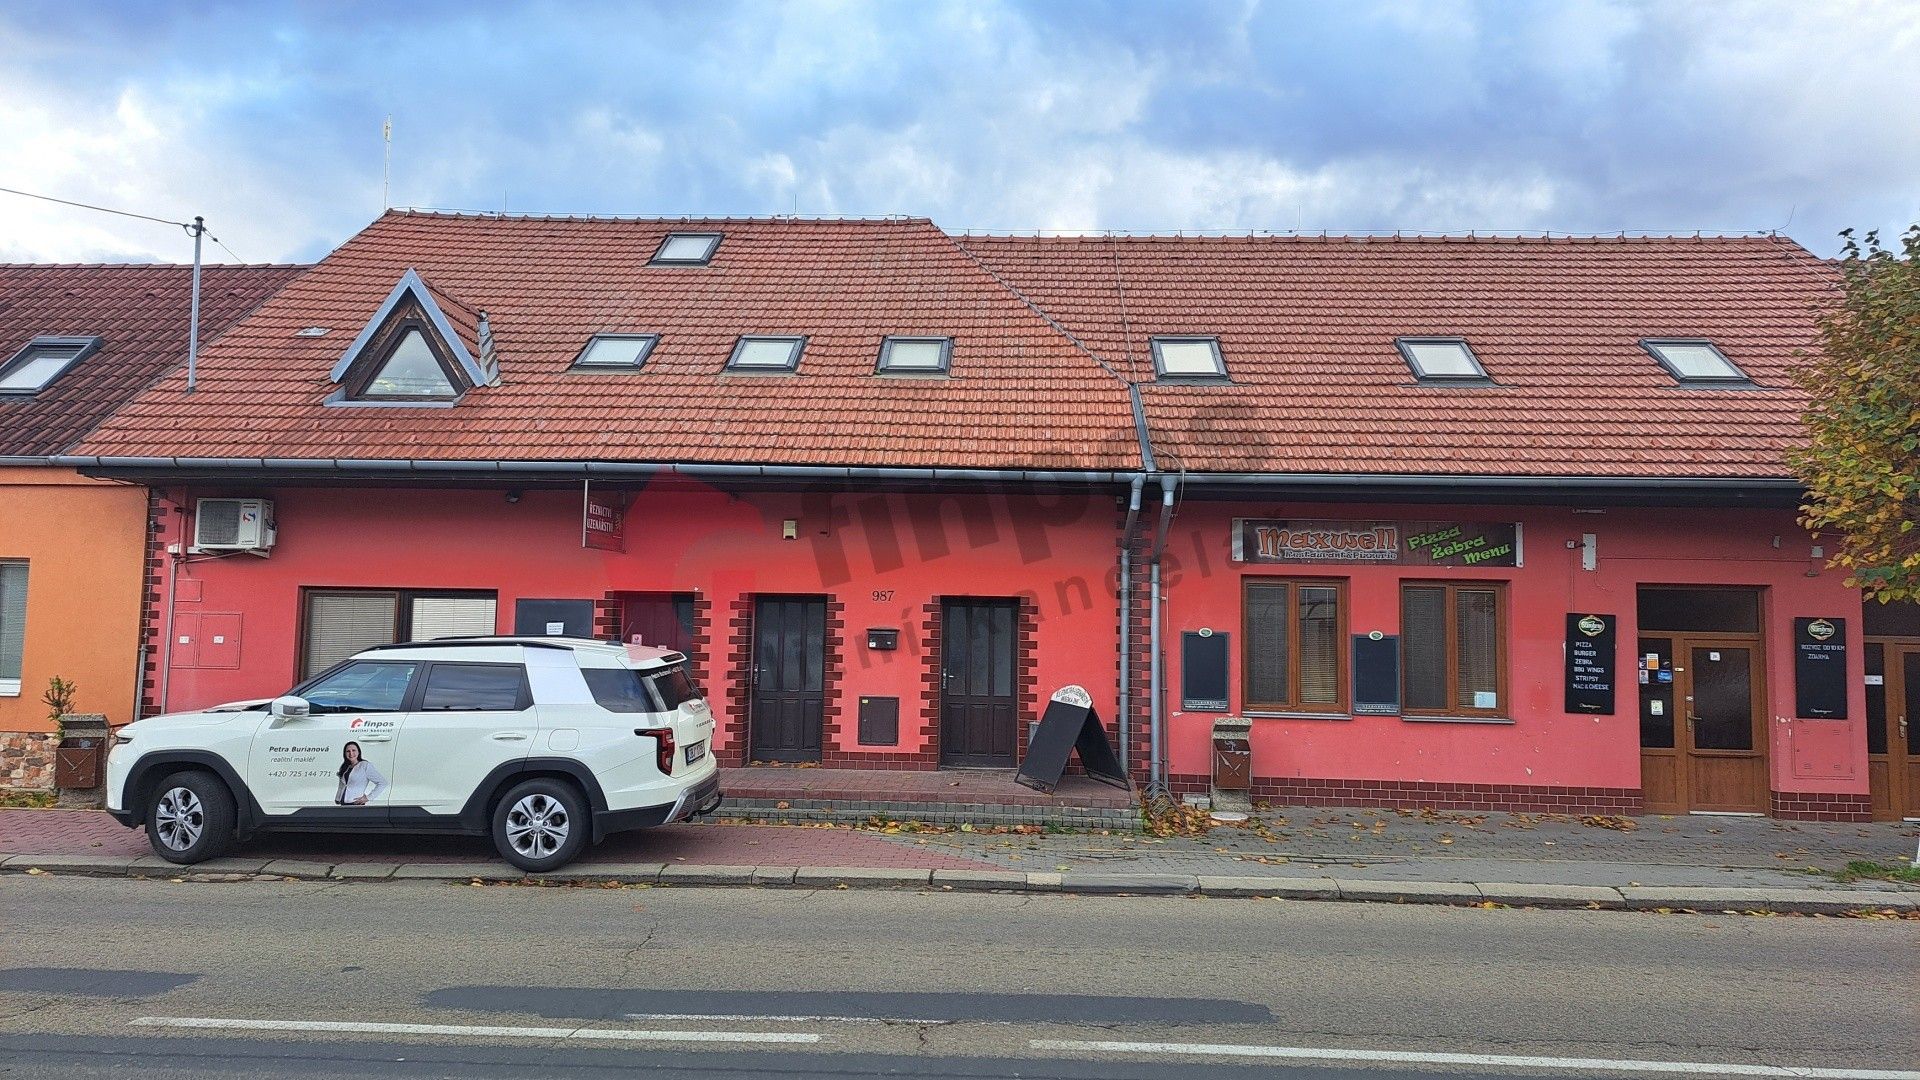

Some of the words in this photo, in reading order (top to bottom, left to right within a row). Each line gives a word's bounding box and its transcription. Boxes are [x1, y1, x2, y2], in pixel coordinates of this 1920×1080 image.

[1258, 527, 1397, 557] Maxwell
[1406, 526, 1462, 550] Pizza
[1431, 535, 1487, 560] Žebra
[1463, 543, 1511, 565] Menu
[872, 590, 895, 602] 987
[363, 720, 395, 729] finpos
[291, 745, 330, 753] Burianová
[267, 770, 287, 778] +420
[318, 769, 332, 777] 771
